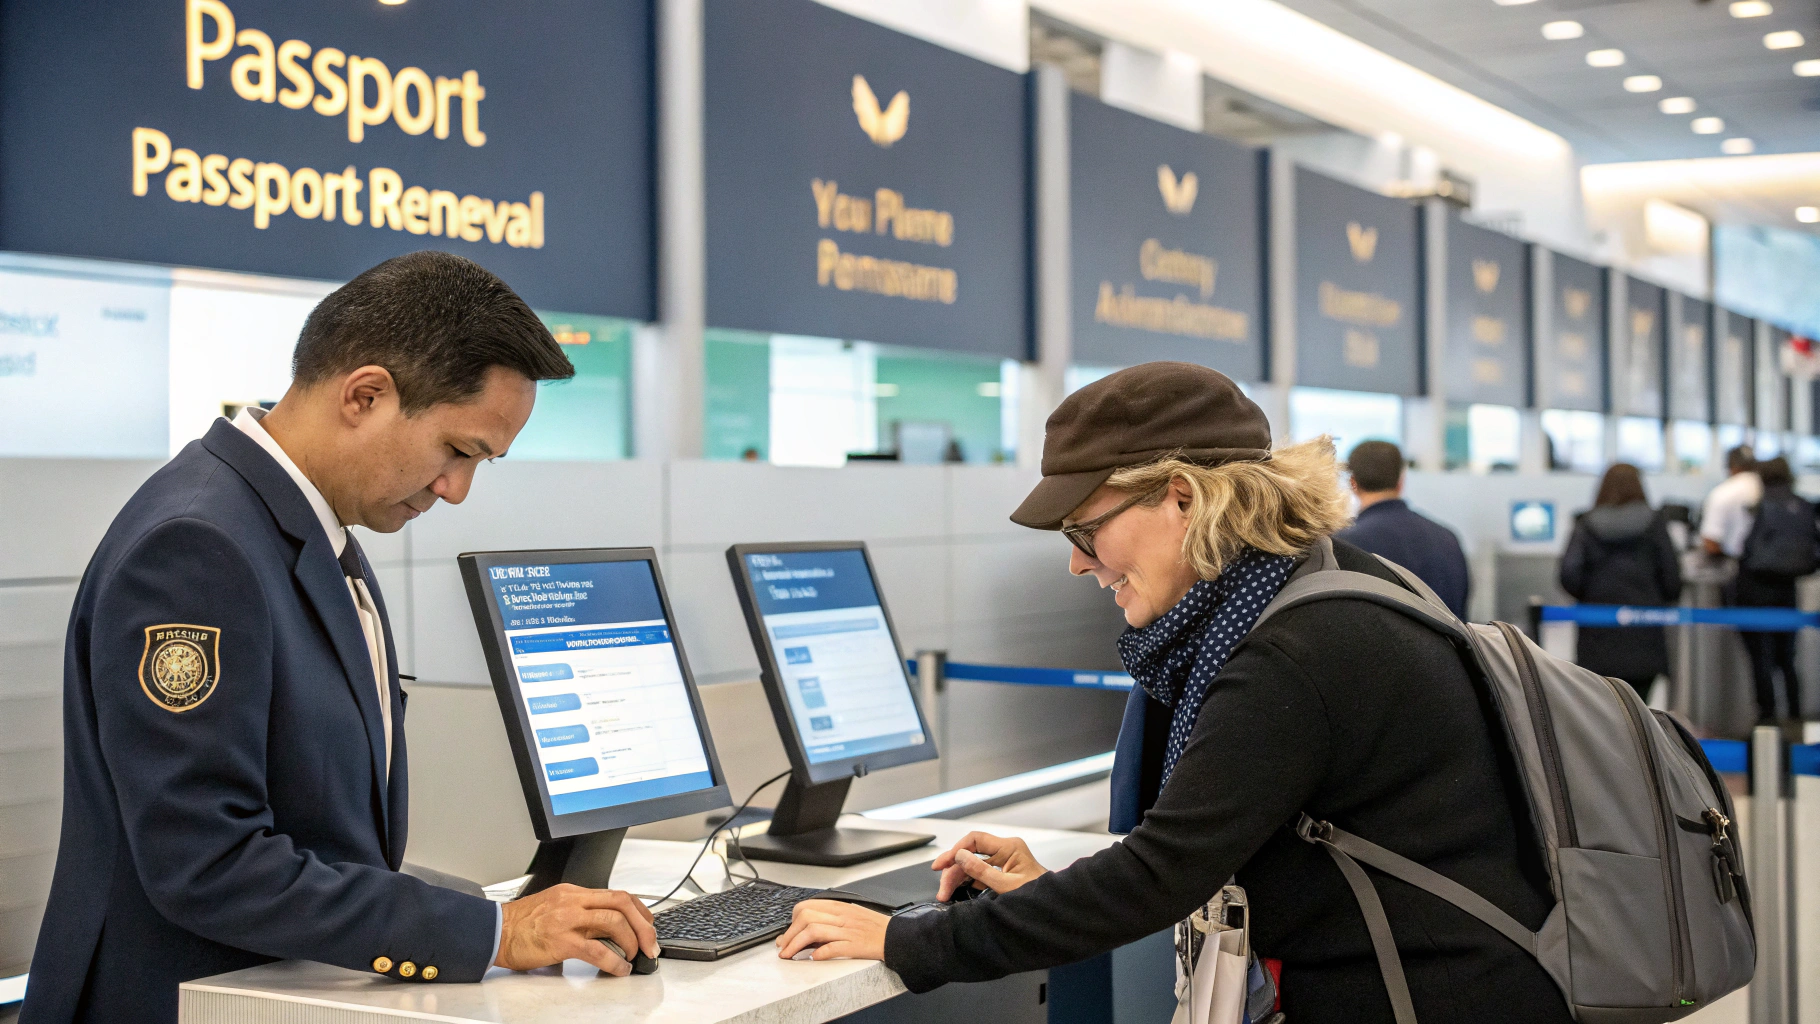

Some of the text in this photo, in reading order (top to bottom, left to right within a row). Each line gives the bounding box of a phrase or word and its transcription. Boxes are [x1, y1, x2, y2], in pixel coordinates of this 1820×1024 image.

[185, 0, 487, 147] Passport
[132, 126, 545, 249] Passport Reneval
